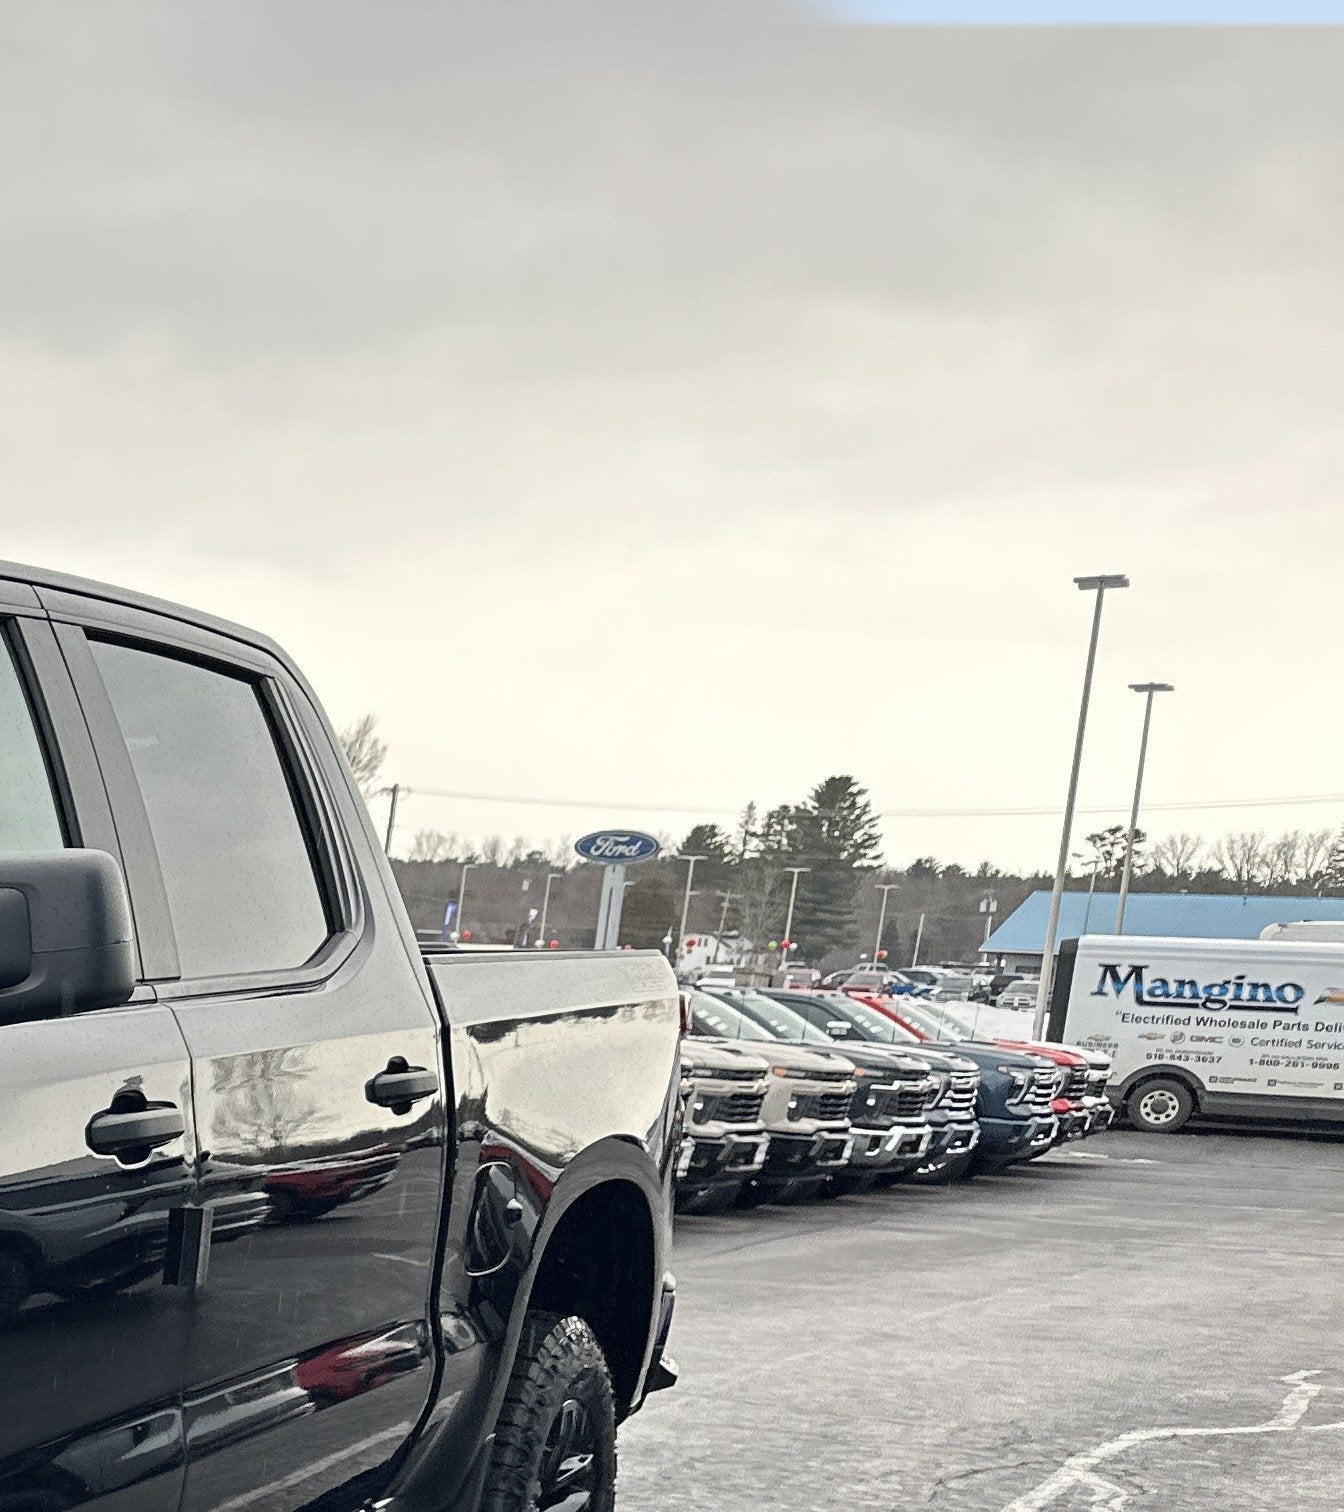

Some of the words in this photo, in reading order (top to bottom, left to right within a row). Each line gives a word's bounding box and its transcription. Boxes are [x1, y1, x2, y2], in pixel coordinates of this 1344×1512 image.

[590, 834, 643, 857] Ford
[1090, 963, 1306, 1012] Mangino
[1196, 1016, 1269, 1030] Wholesale
[1272, 1020, 1310, 1032] Parts
[1251, 1037, 1302, 1049] Certified
